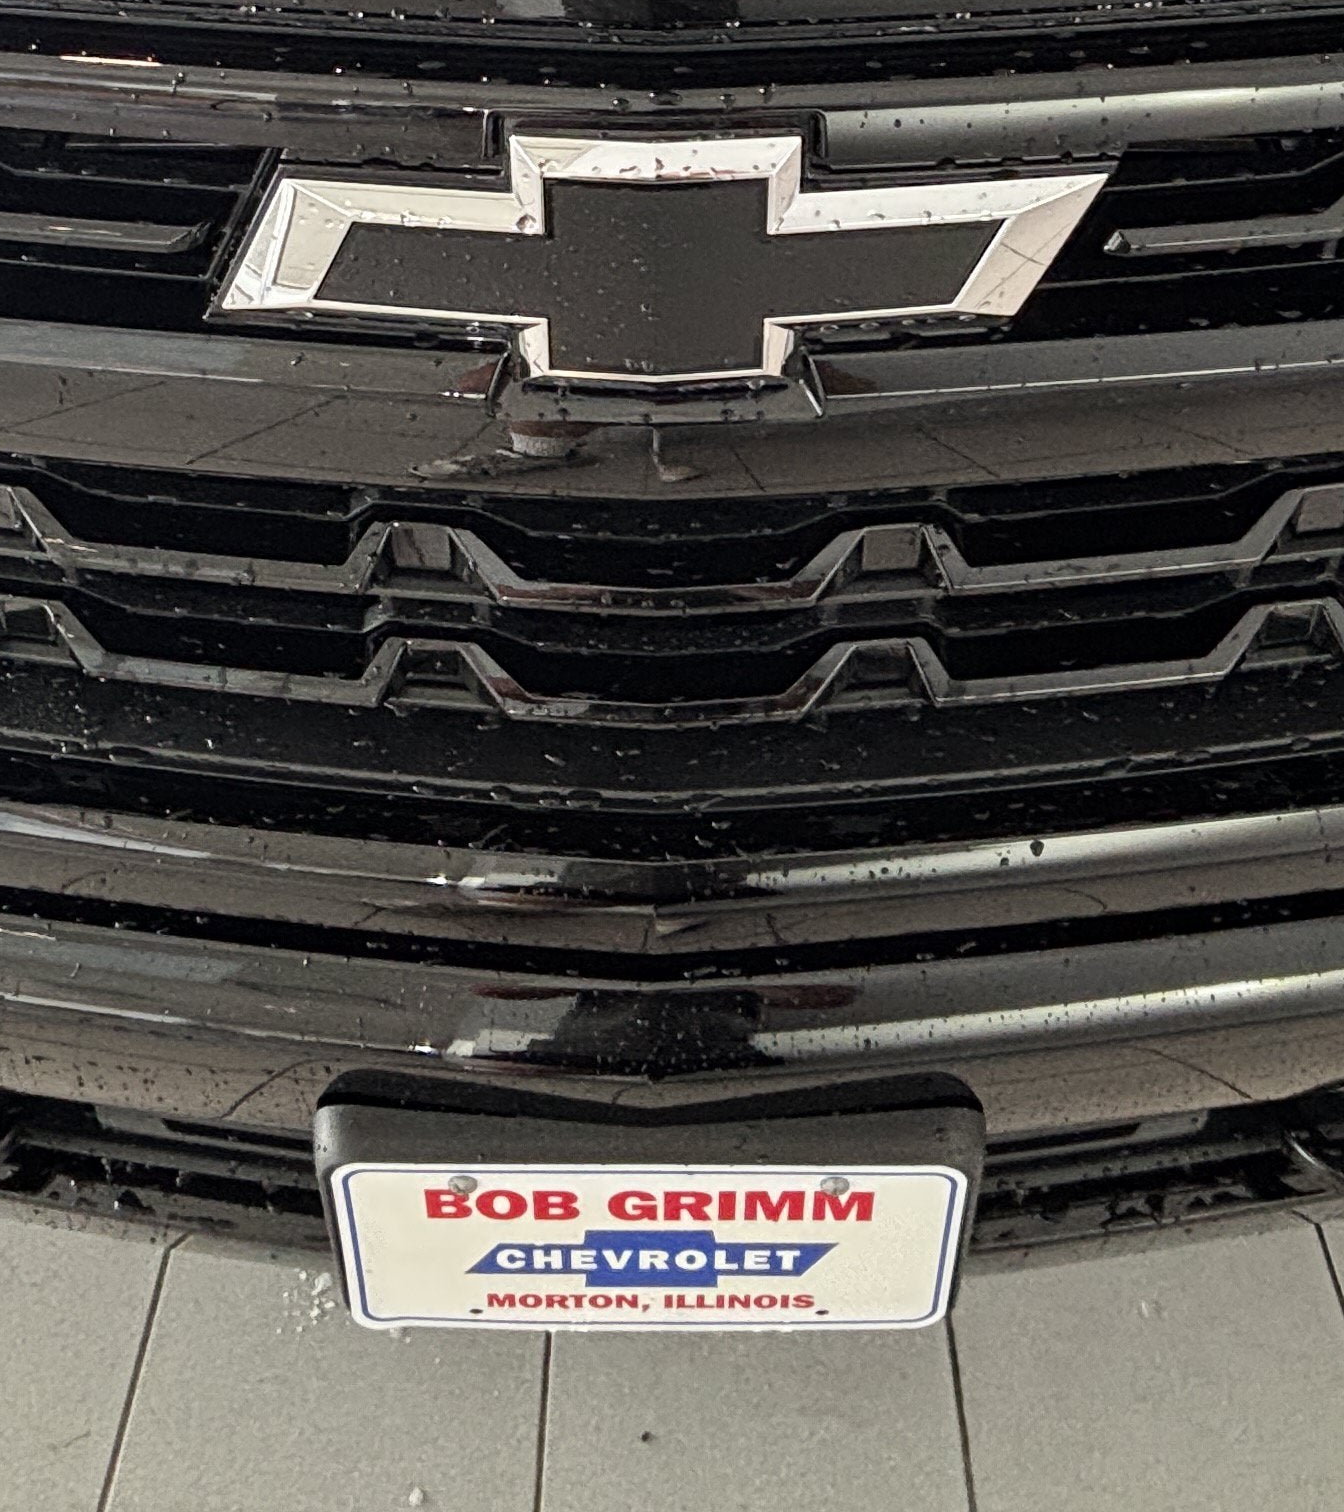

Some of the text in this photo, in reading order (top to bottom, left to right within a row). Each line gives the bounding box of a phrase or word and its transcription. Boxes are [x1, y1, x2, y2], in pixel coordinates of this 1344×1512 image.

[424, 1188, 876, 1222] BOB GRIMM
[496, 1248, 802, 1271] CHEVROLET
[486, 1293, 816, 1313] MORTON, ILLINOIS
